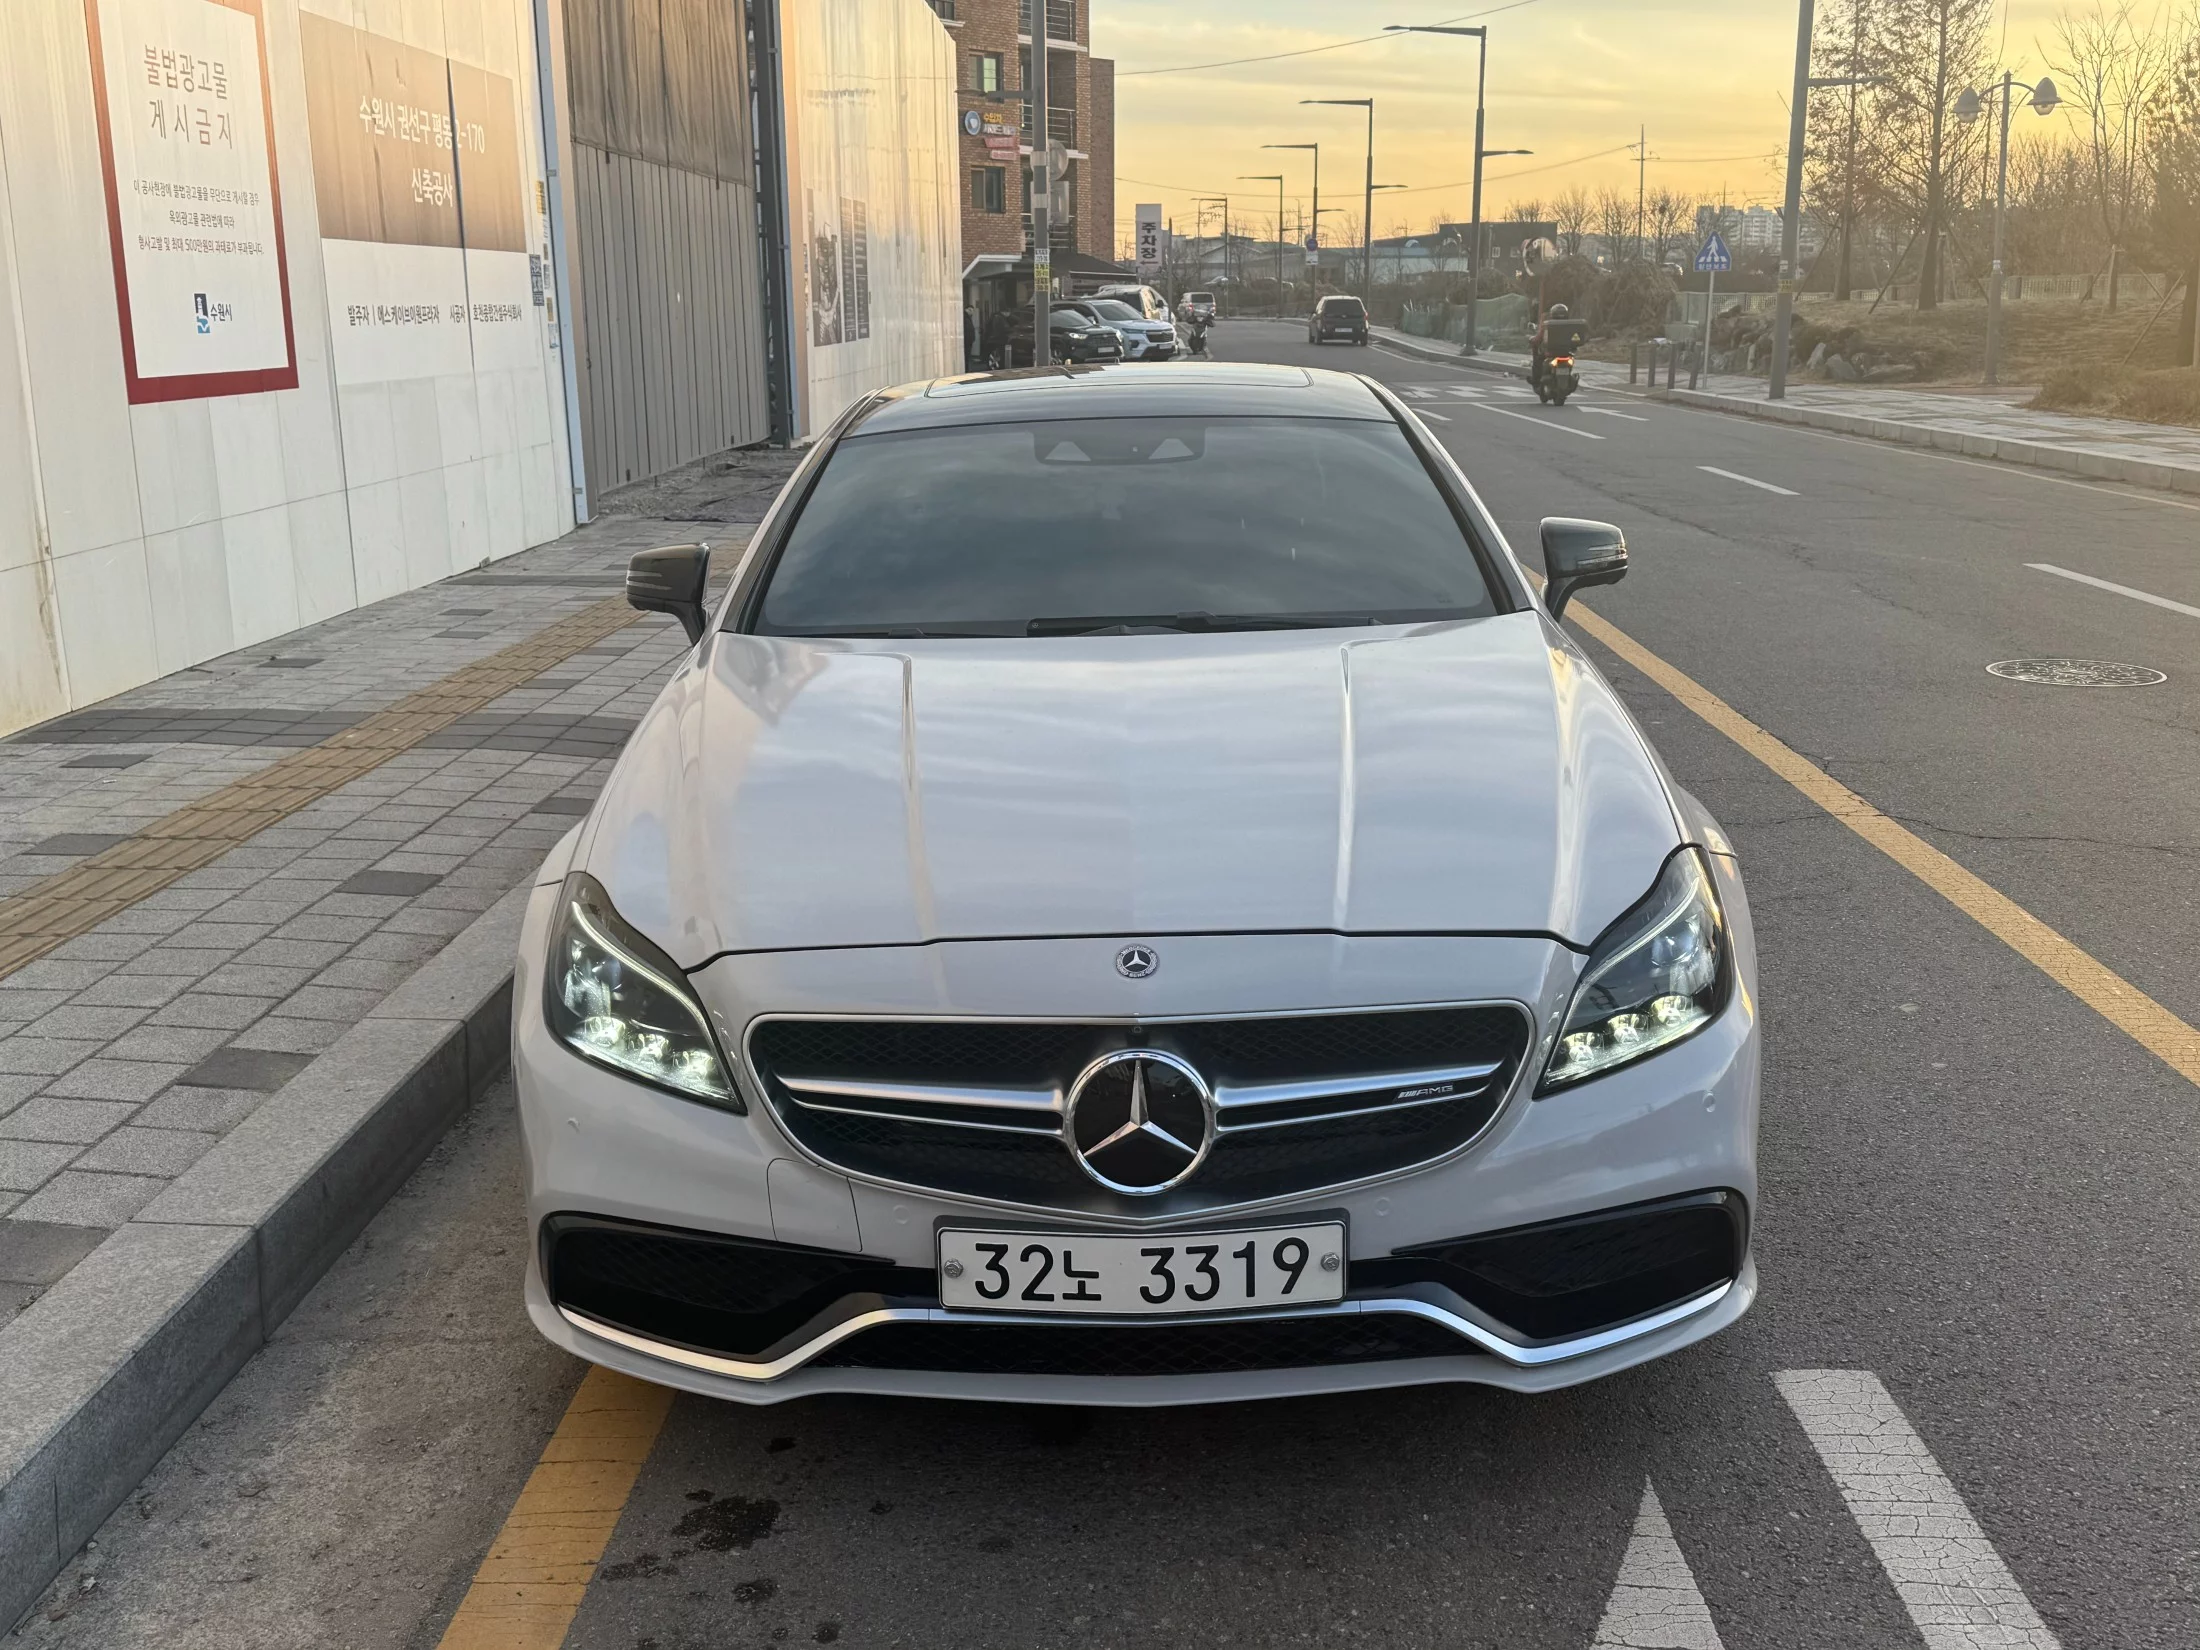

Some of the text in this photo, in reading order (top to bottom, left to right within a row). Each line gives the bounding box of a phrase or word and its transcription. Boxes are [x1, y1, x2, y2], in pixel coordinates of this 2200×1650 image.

[143, 44, 228, 99] 불법광고물
[359, 95, 397, 138] 수원시
[397, 104, 432, 145] 권선구
[173, 185, 208, 201] 불법광고물을
[209, 188, 232, 203] 무단으로
[411, 167, 453, 207] 신축공사
[169, 210, 199, 226] 옥외광고물
[223, 216, 235, 228] 따라
[138, 235, 163, 250] 형사고발
[171, 238, 183, 251] 최대
[1141, 222, 1158, 259] 주차장
[210, 303, 232, 321] 수원시
[347, 304, 370, 327] 발주자
[449, 304, 467, 324] 시공자
[973, 1236, 1310, 1304] 32노 3319
